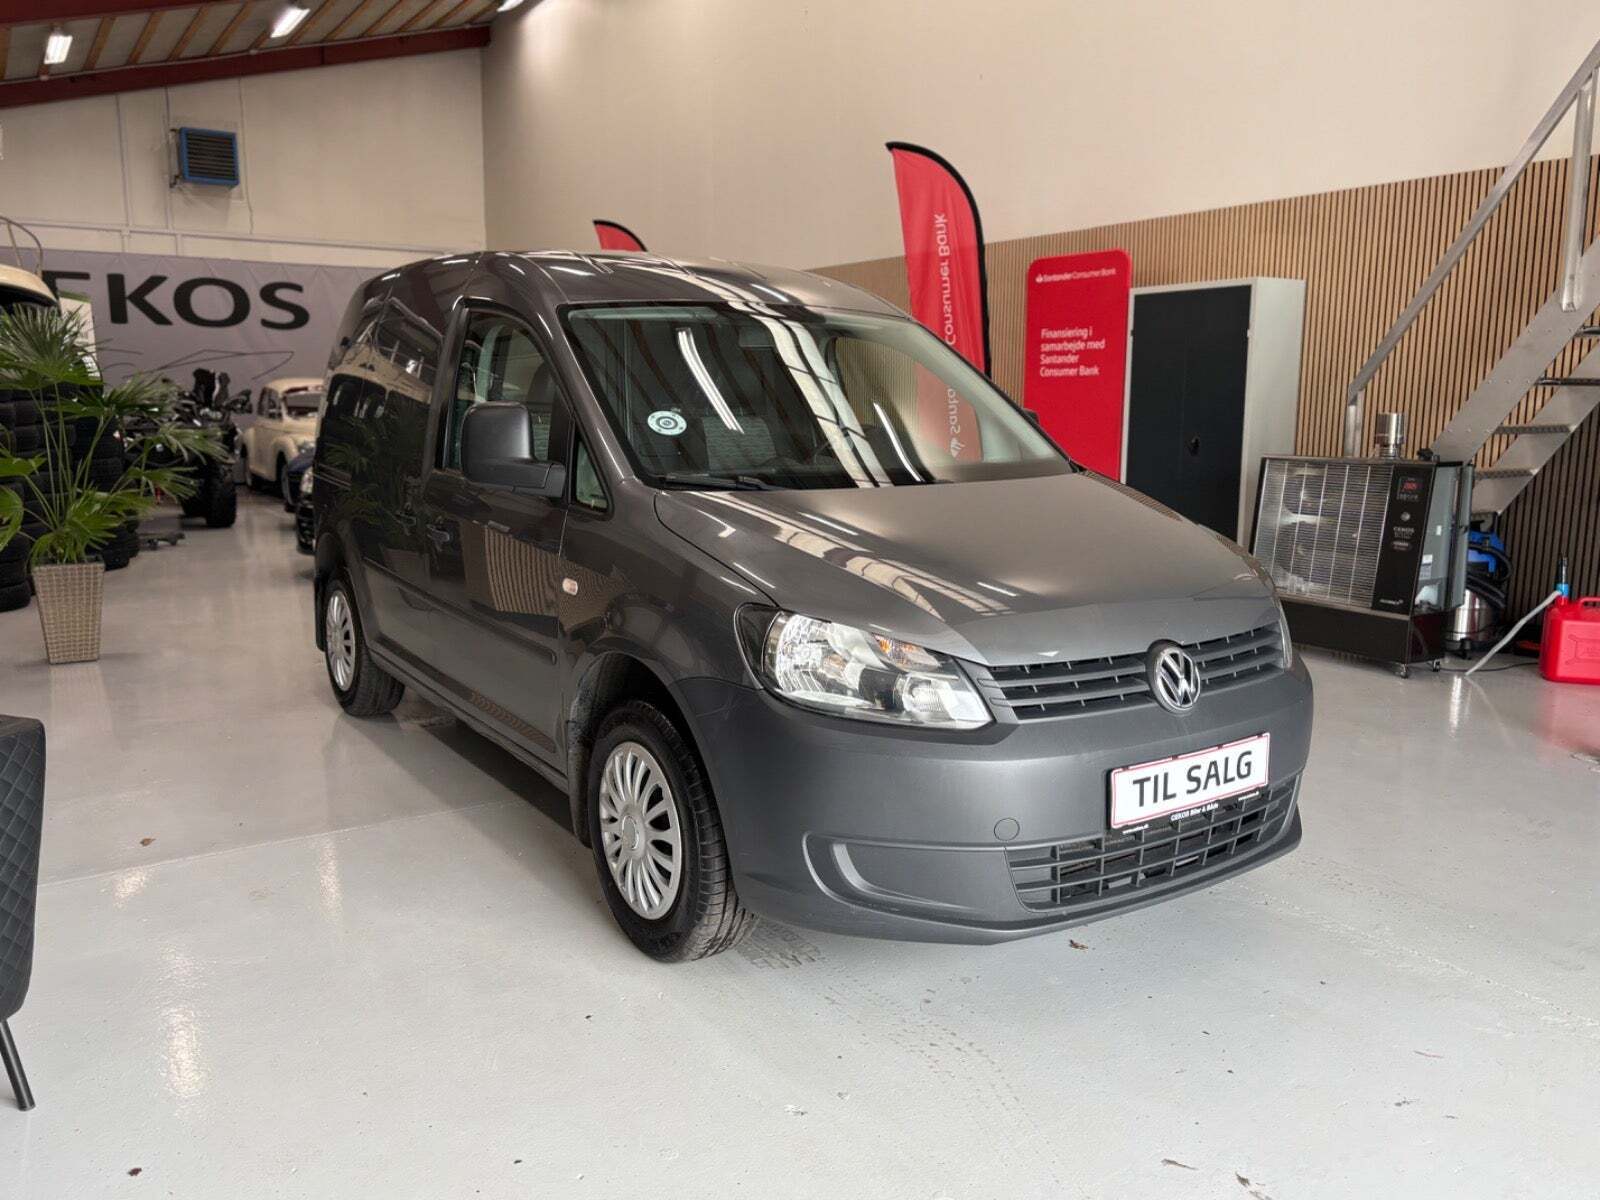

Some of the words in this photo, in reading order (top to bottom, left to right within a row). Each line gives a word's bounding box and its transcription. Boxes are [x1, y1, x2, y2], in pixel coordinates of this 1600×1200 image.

[1041, 327, 1088, 339] Finansiering
[1040, 339, 1085, 353] samarbejde
[1087, 339, 1105, 349] med
[1040, 354, 1079, 365] Santander
[1040, 366, 1078, 378] Consumer
[1079, 366, 1099, 376] Bank
[1133, 772, 1177, 807] TIL
[1186, 751, 1252, 795] SALG
